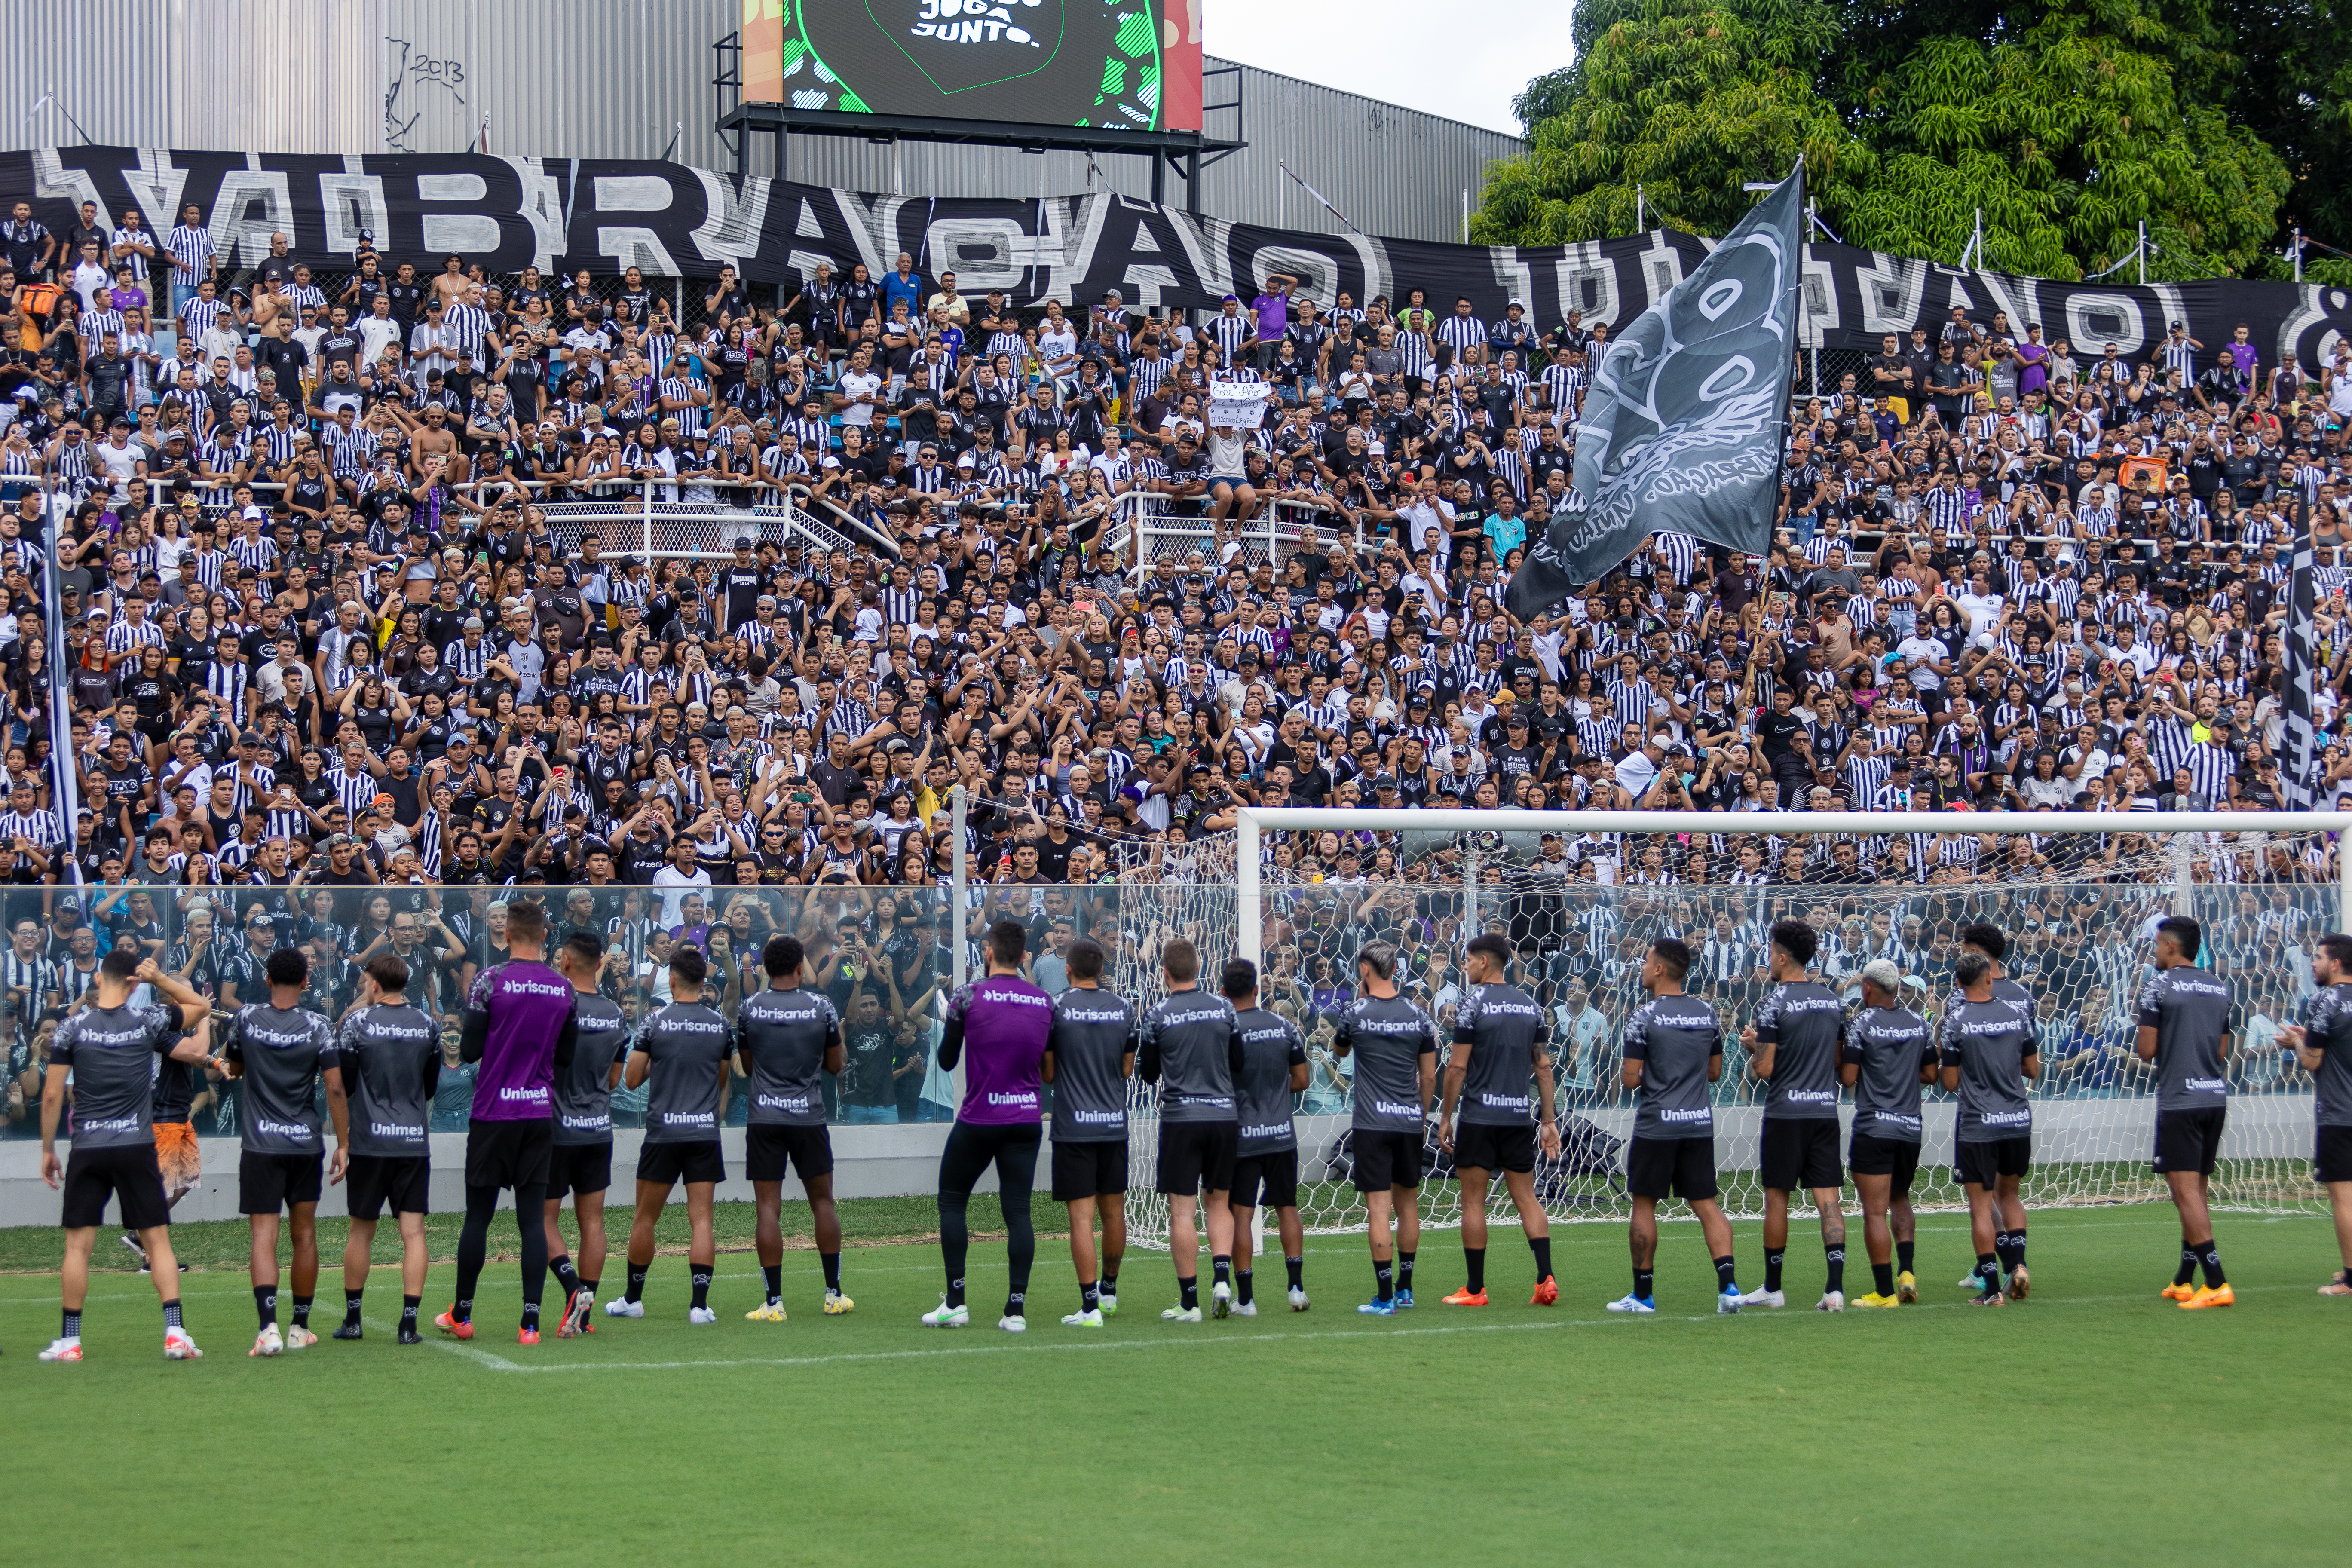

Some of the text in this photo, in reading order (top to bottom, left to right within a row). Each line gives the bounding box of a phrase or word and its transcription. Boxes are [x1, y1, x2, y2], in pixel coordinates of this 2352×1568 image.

[409, 55, 465, 83] 2013
[731, 574, 757, 584] ALIANÇA
[585, 680, 619, 692] LOUCOS
[1503, 761, 1531, 772] LOUCOS
[511, 980, 566, 997] brisanet
[2178, 979, 2226, 996] brisanet
[991, 989, 1048, 1007] brisanet
[1792, 997, 1839, 1011] brisanet
[756, 1006, 816, 1019] brisanet
[1072, 1008, 1124, 1020] brisanet
[1487, 1001, 1536, 1015] brisanet
[578, 1013, 621, 1029] risanet
[1170, 1008, 1226, 1024] brisanet
[1661, 1014, 1711, 1025] brisanet
[374, 1021, 432, 1038] brisanet
[667, 1017, 723, 1033] brisanet
[1365, 1018, 1420, 1032] brisanet
[1875, 1025, 1924, 1038] brisanet
[1968, 1019, 2021, 1033] brisanet
[87, 1025, 147, 1044] brisanet
[254, 1021, 314, 1044] brisanet
[1242, 1026, 1286, 1042] risanet
[2185, 1078, 2225, 1090] Unimed
[501, 1086, 548, 1101] Unimed
[989, 1092, 1037, 1106] Unimed
[1482, 1093, 1530, 1106] Unimed
[1788, 1089, 1834, 1101] Unimed
[759, 1094, 808, 1108] Unimed
[1376, 1101, 1421, 1115] Unimed
[563, 1113, 610, 1128] Unimed
[664, 1112, 714, 1124] Unimed
[1075, 1109, 1123, 1122] Unimed
[1661, 1106, 1710, 1122] Unimed
[1981, 1108, 2030, 1125] Unimed
[372, 1123, 423, 1135] Unimed
[1242, 1121, 1291, 1138] Unimed
